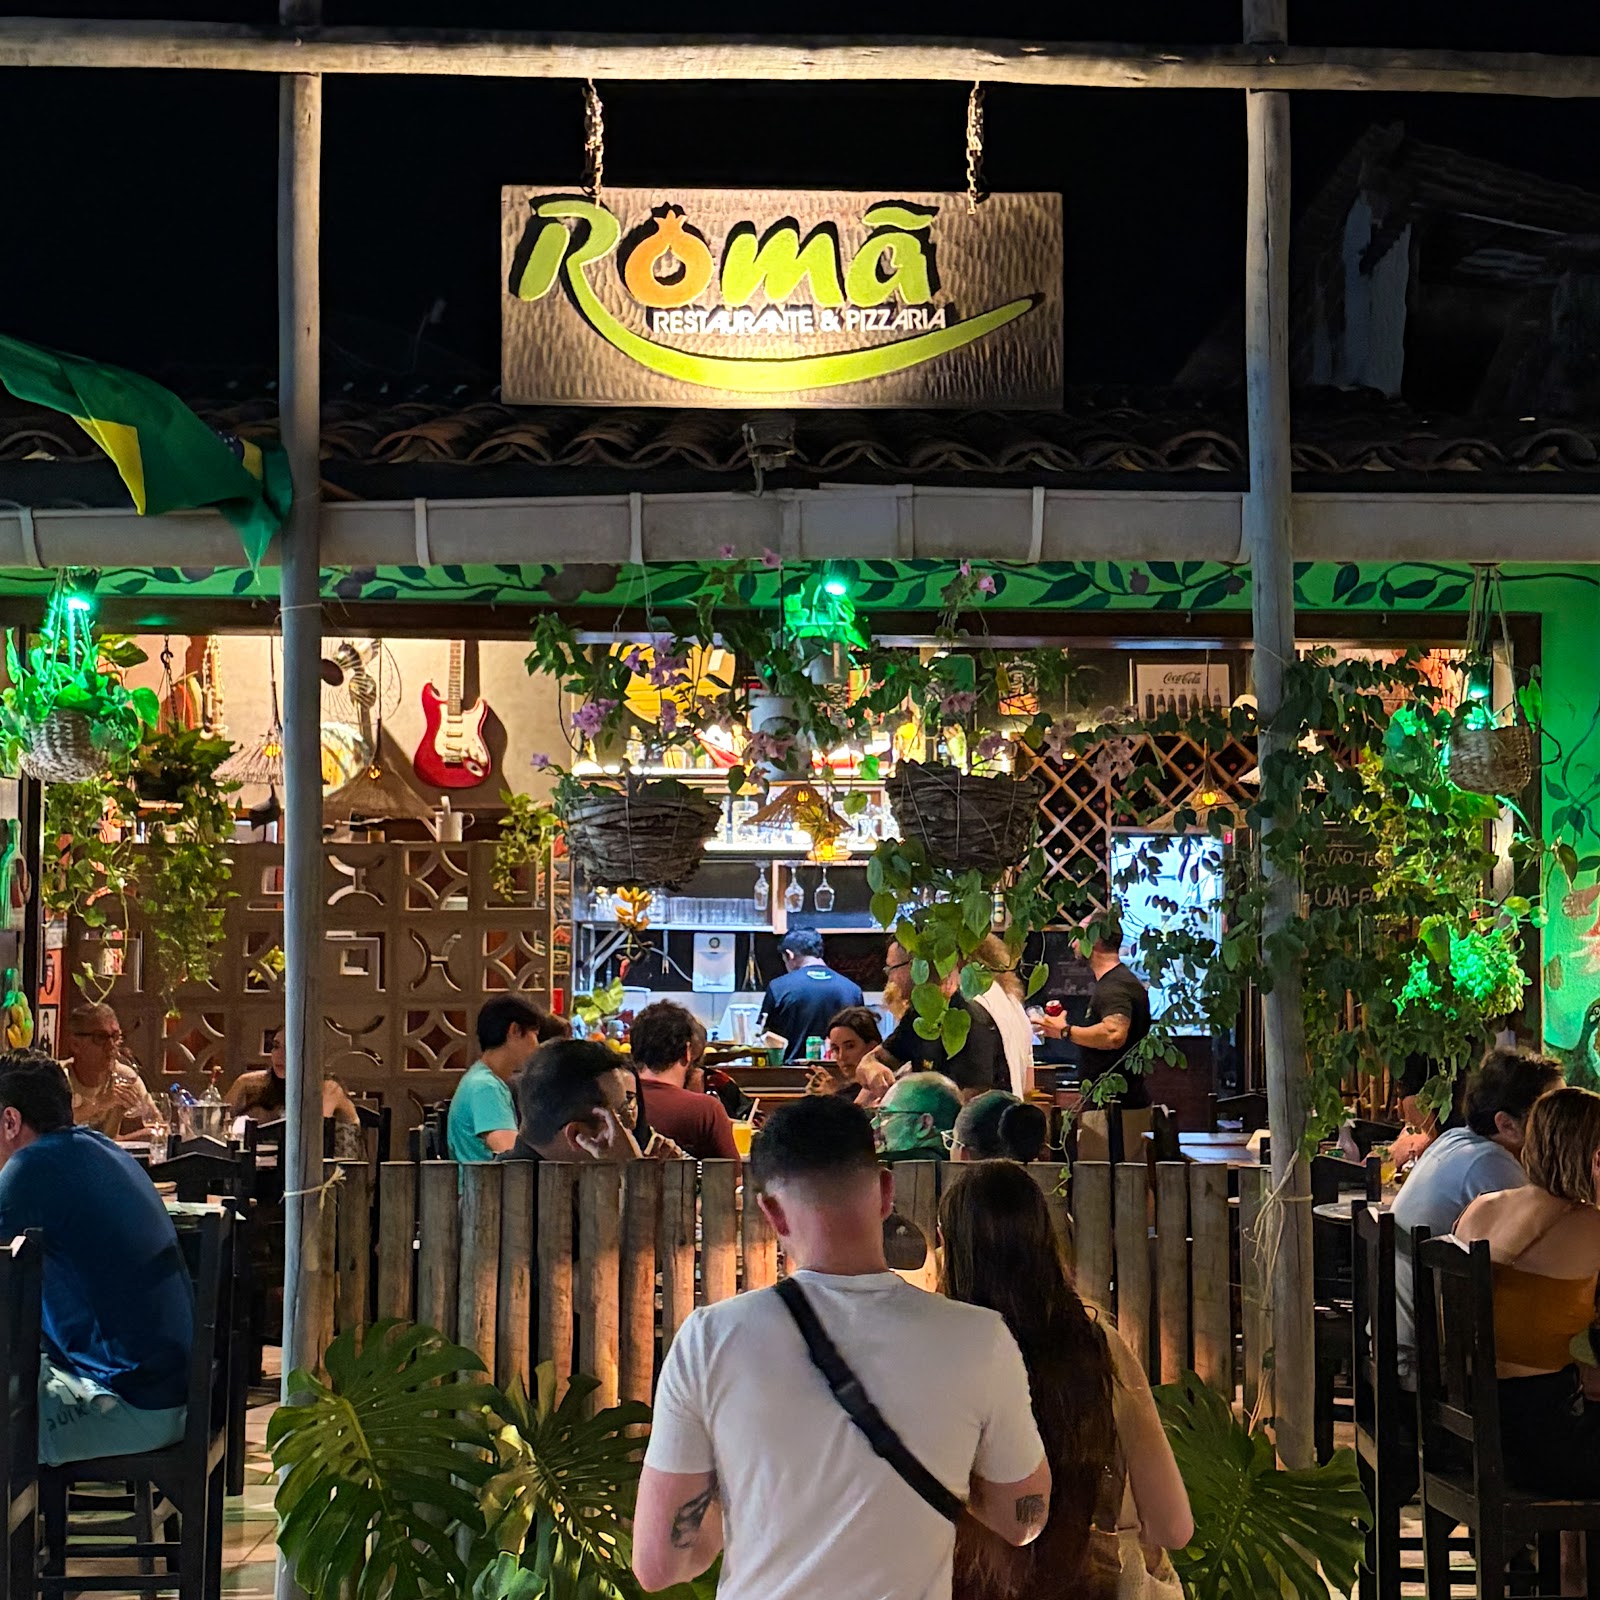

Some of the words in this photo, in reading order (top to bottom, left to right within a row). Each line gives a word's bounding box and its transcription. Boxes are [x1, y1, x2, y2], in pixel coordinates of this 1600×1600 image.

[653, 309, 813, 334] RESTAURANTE
[820, 310, 841, 332] &
[846, 308, 946, 331] PIZZARIA
